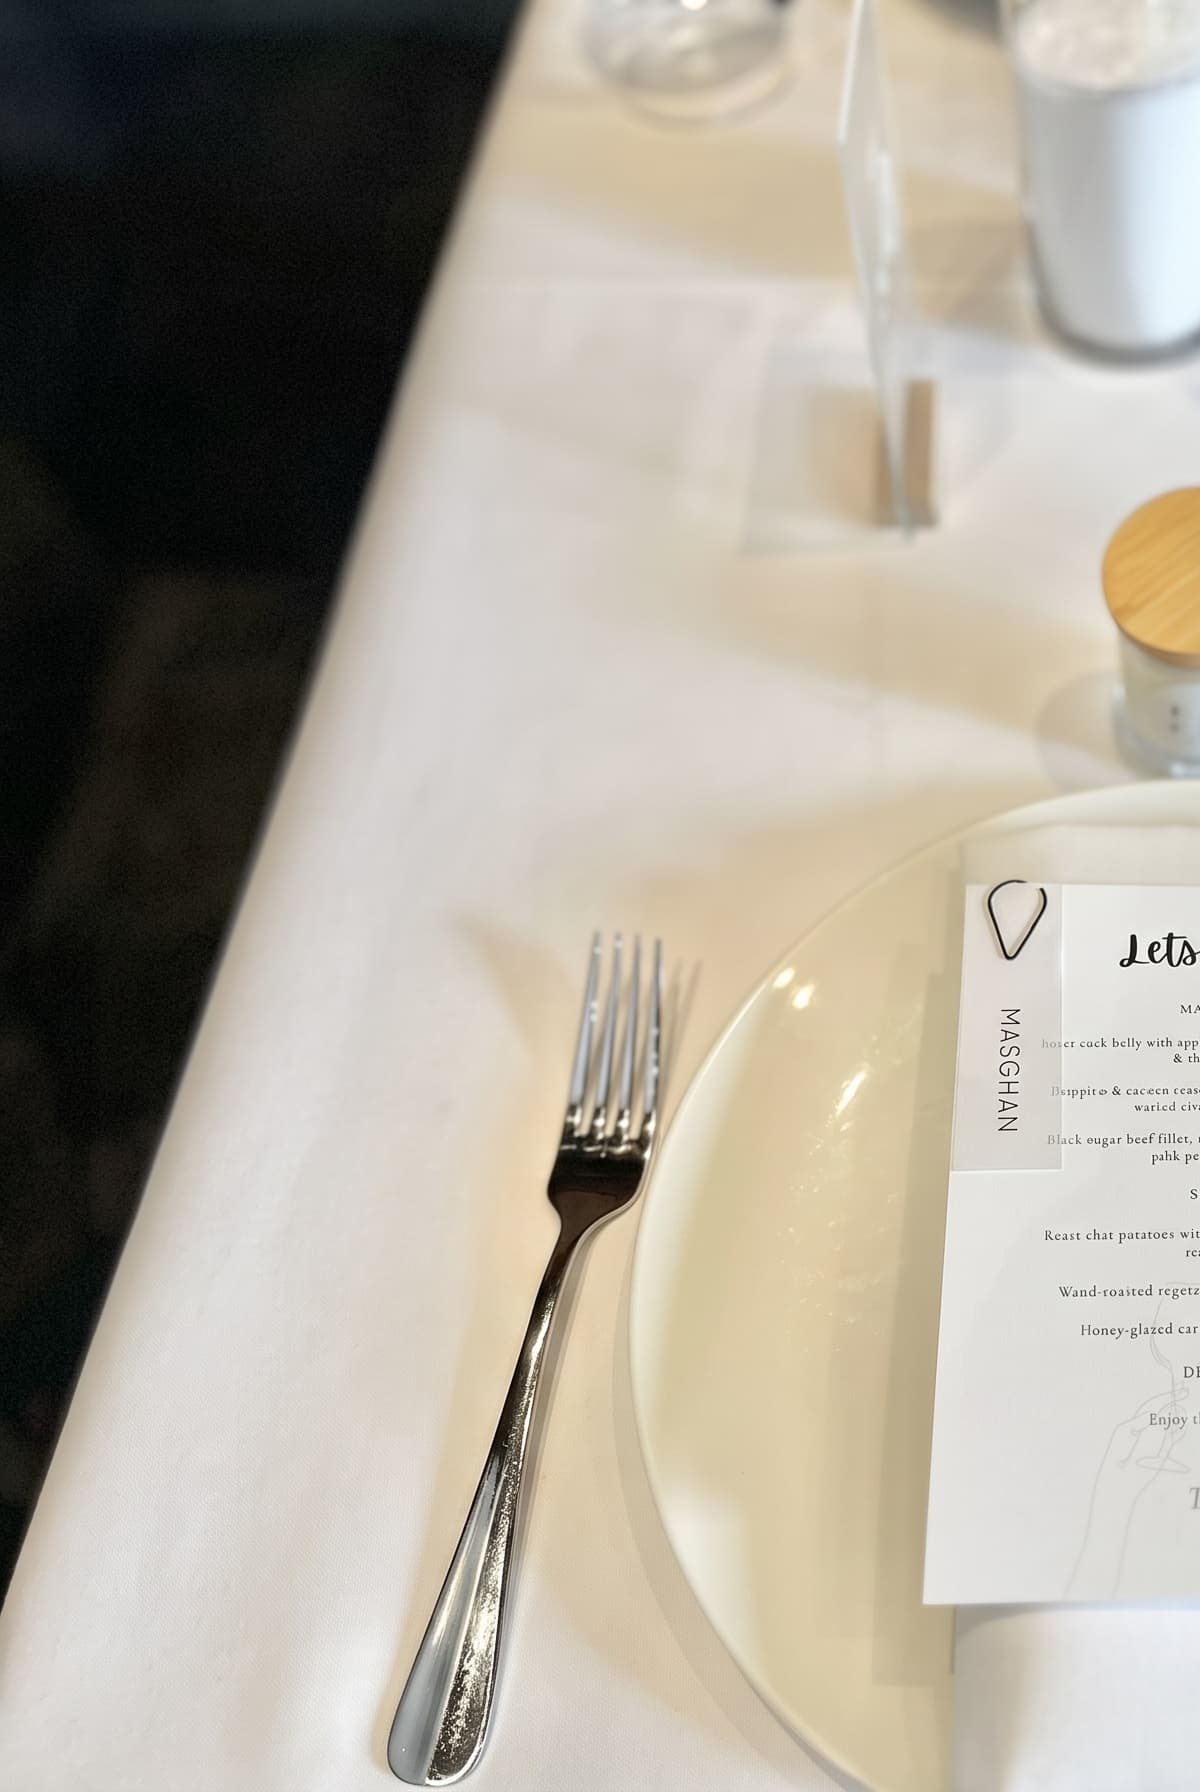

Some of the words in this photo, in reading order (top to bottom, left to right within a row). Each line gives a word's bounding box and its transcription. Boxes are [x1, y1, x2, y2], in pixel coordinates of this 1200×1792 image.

[1112, 1038, 1142, 1051] belly
[1147, 1038, 1172, 1047] with
[1173, 1053, 1182, 1063] &
[997, 1008, 1022, 1133] MASGHAN
[1112, 1086, 1121, 1095] &
[1048, 1134, 1082, 1145] Black
[1127, 1133, 1155, 1144] beef
[1086, 1229, 1113, 1240] chat
[1148, 1413, 1188, 1430] Enjoy
